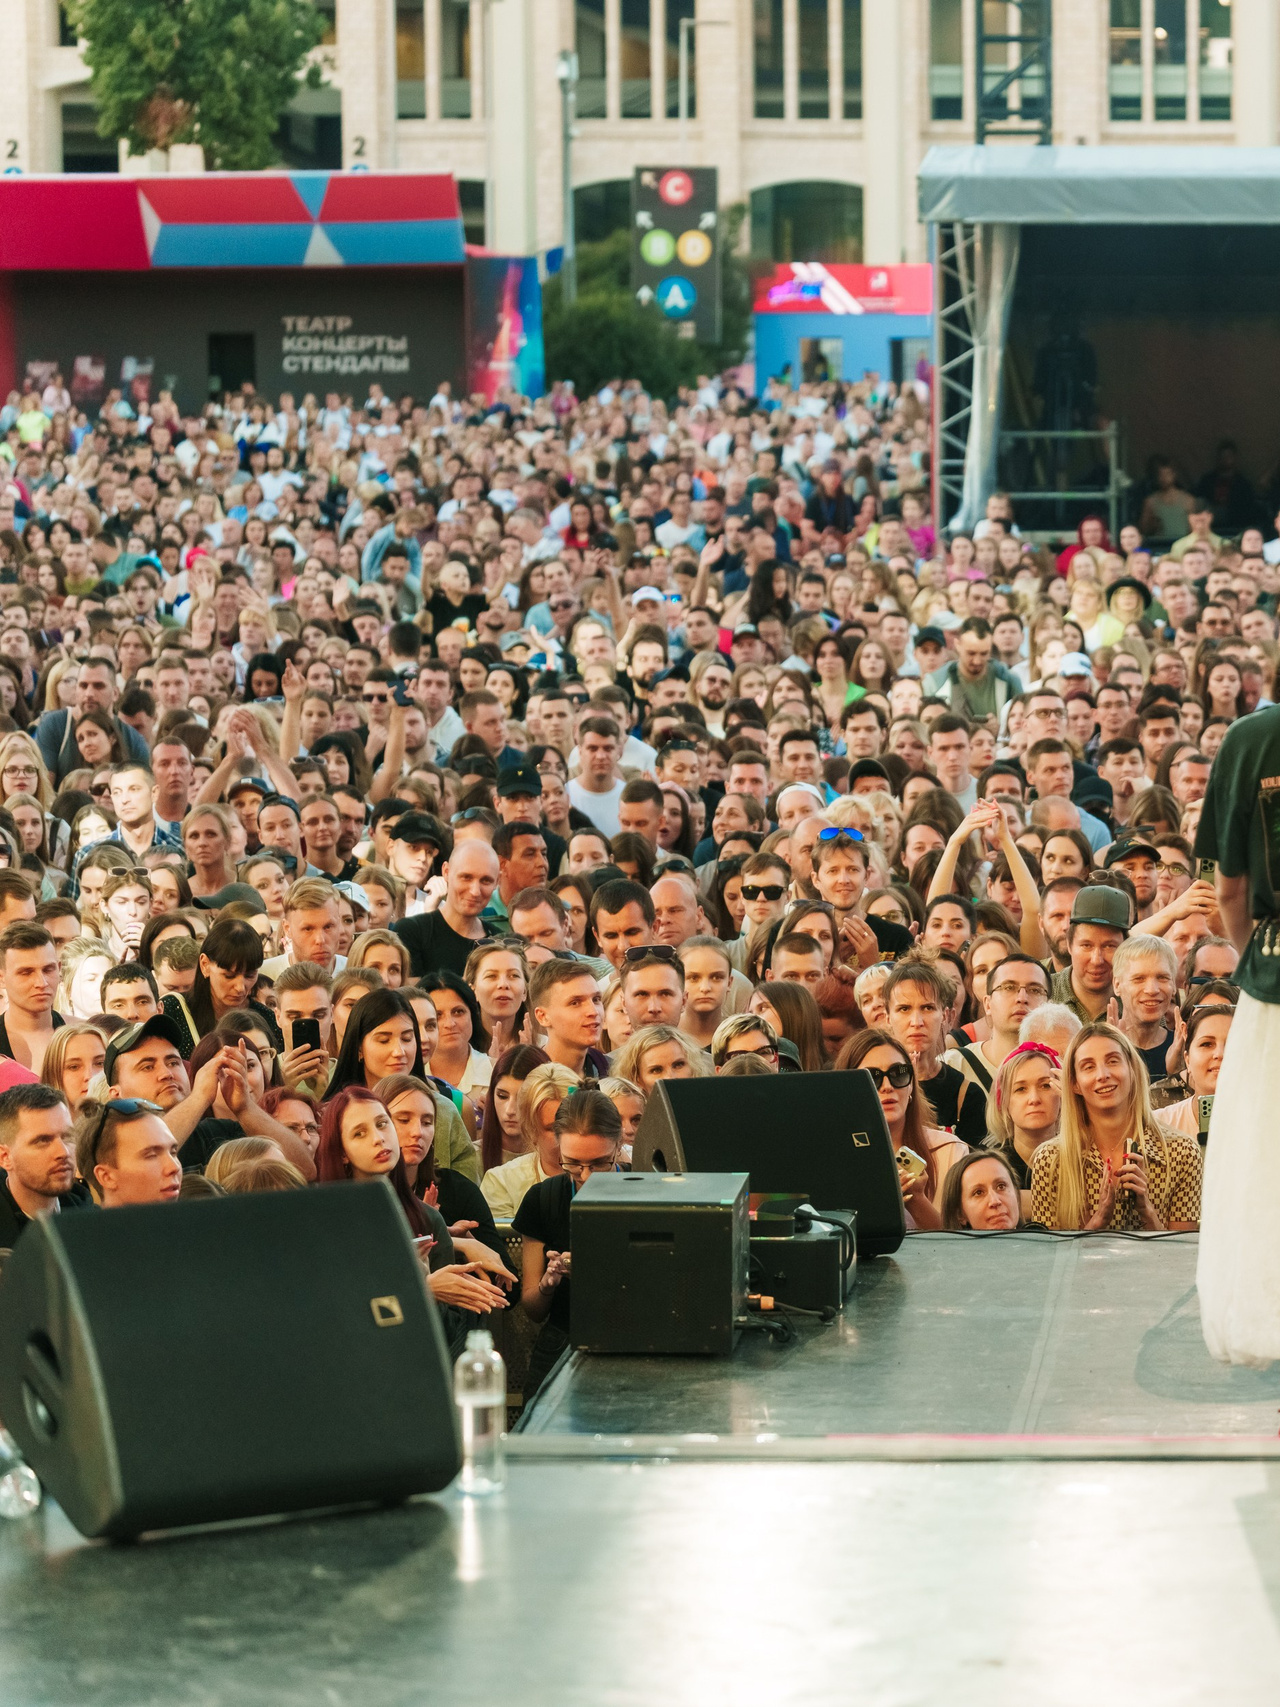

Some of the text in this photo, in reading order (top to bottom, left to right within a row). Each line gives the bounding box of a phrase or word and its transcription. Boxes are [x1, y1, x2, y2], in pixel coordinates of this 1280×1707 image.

[6, 139, 19, 159] 2
[352, 136, 366, 157] 2
[665, 176, 686, 200] C
[664, 284, 688, 309] A
[282, 315, 354, 333] ТЕАТР
[282, 334, 408, 354] КОНЦЕРТЫ
[282, 354, 410, 376] СТЕНДАПЫ
